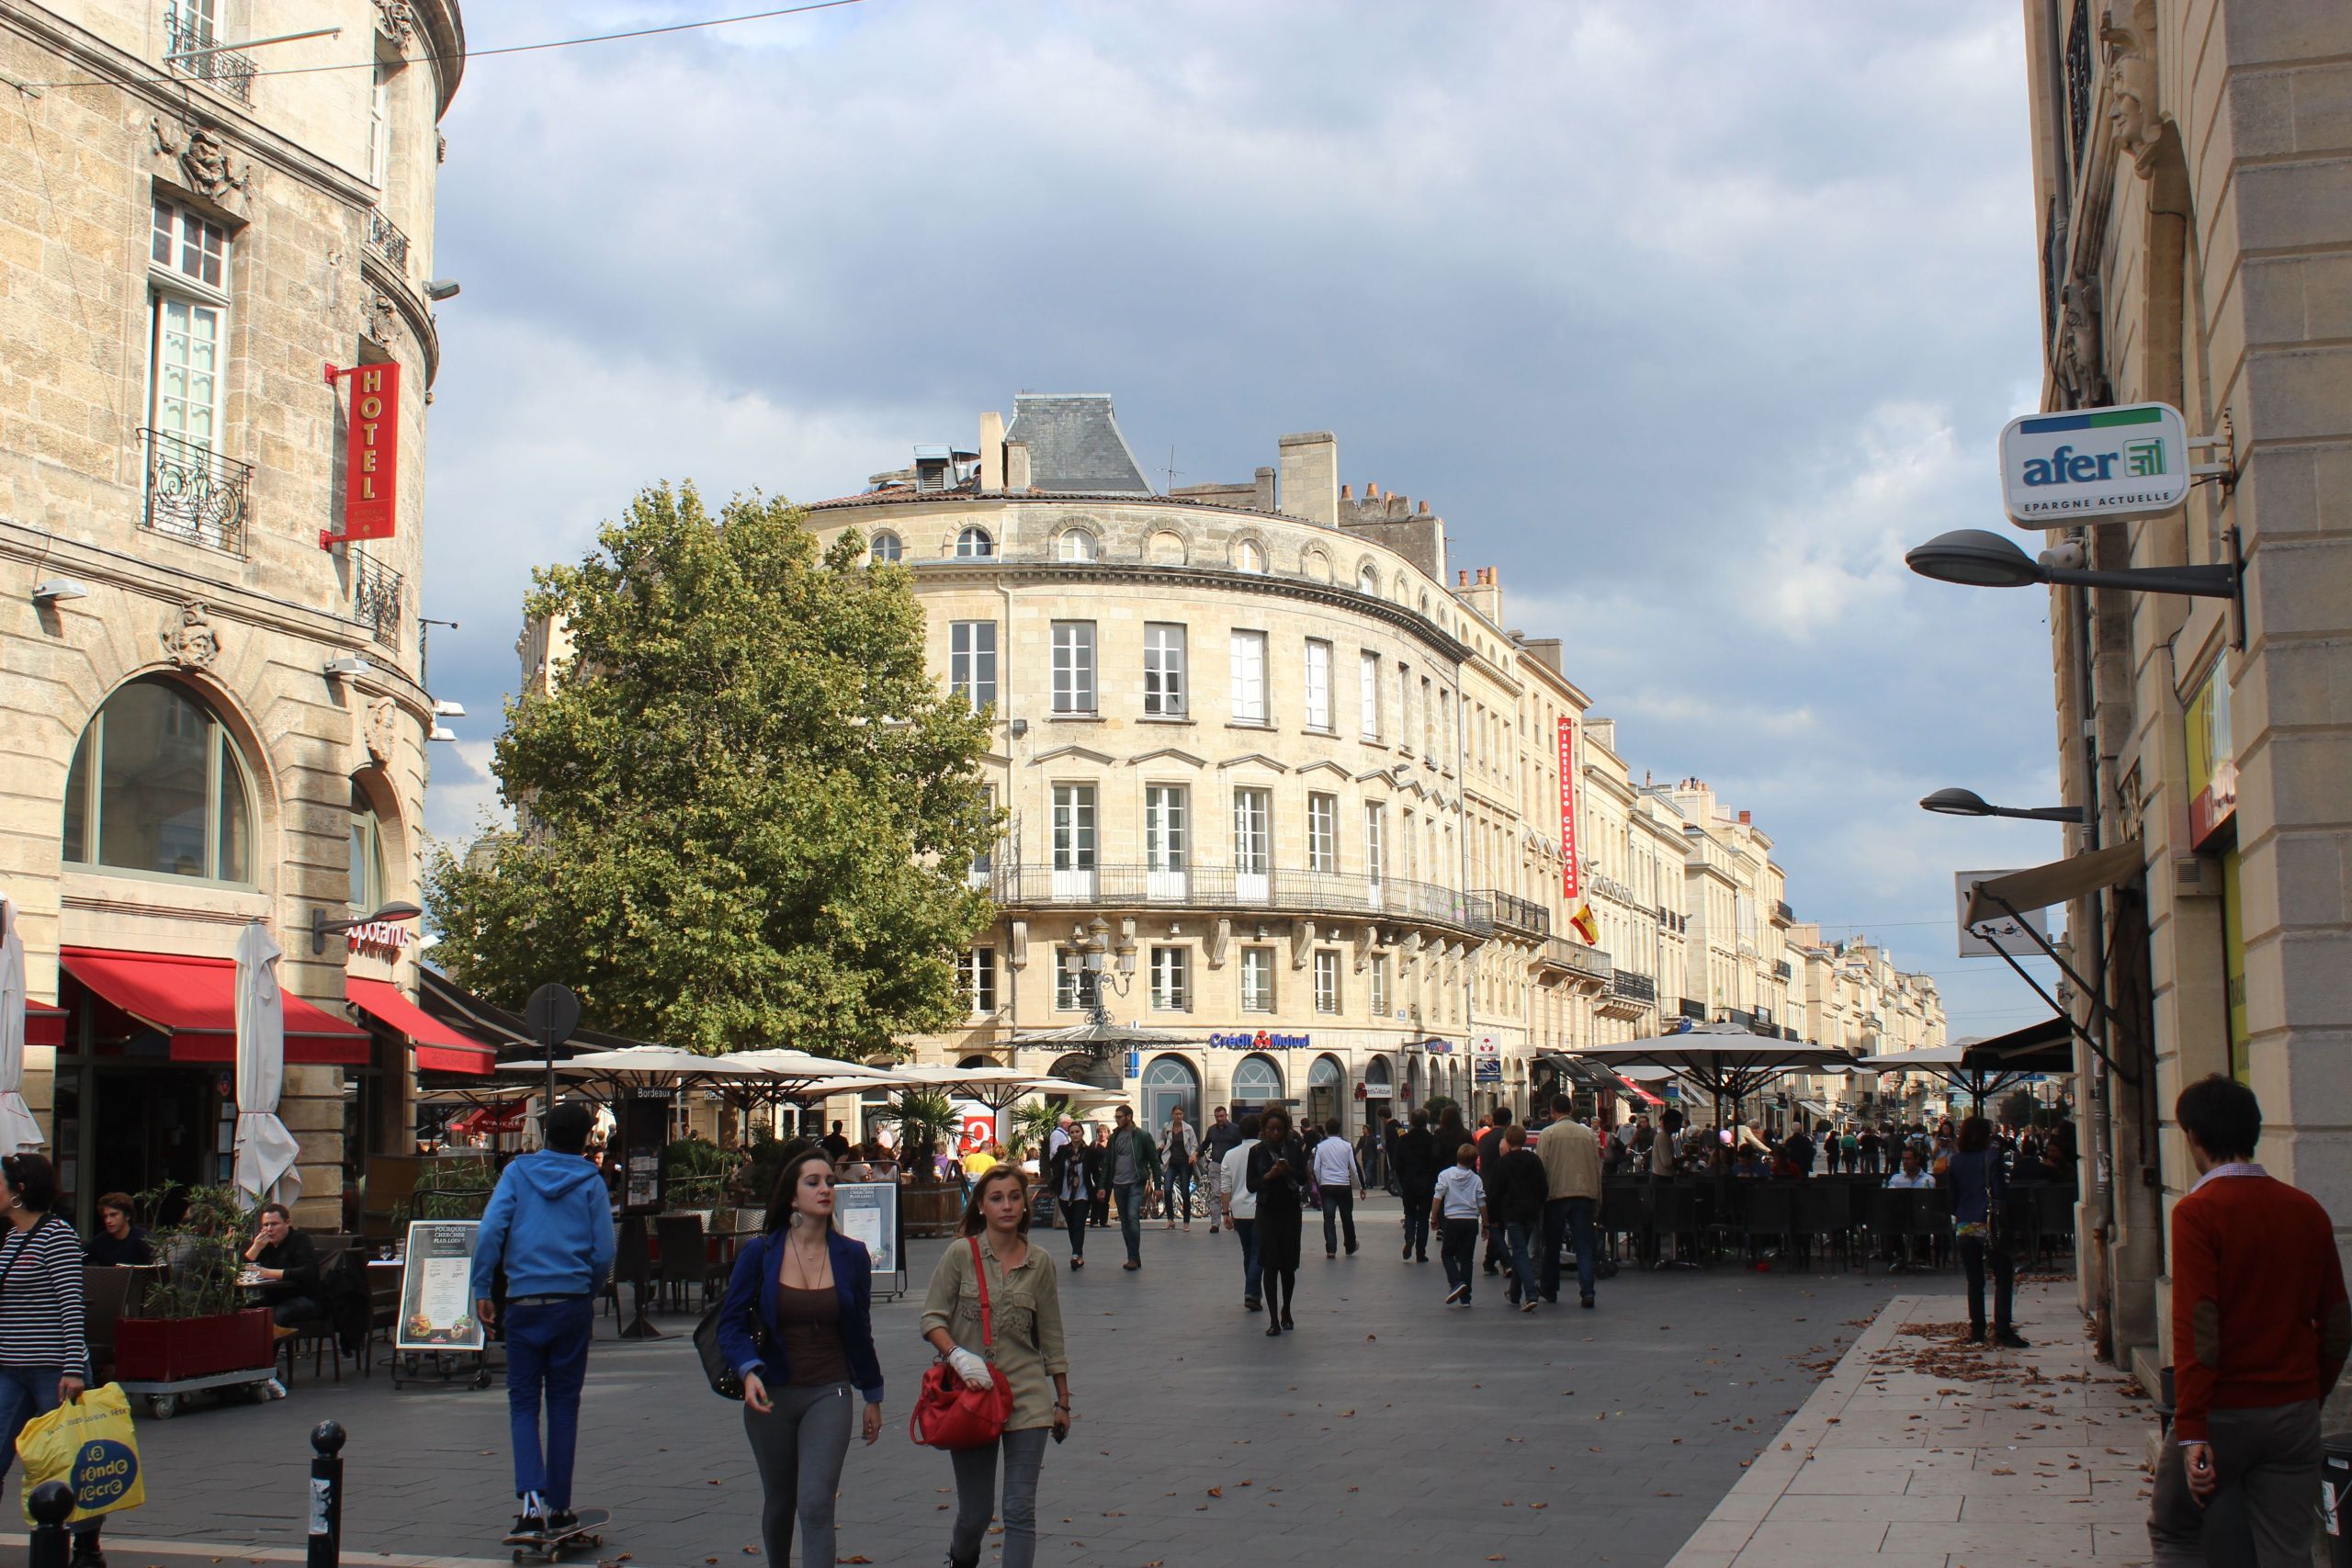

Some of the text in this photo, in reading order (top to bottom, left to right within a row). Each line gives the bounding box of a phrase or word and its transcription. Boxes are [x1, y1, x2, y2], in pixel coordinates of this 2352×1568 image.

[360, 369, 381, 500] HOTEL
[2023, 445, 2119, 487] afer
[2024, 492, 2169, 512] EPARGNE ACTUELLE
[1563, 816, 1574, 889] Cervantes
[1210, 1032, 1253, 1048] Crédit
[638, 1088, 672, 1099] Bordeaux
